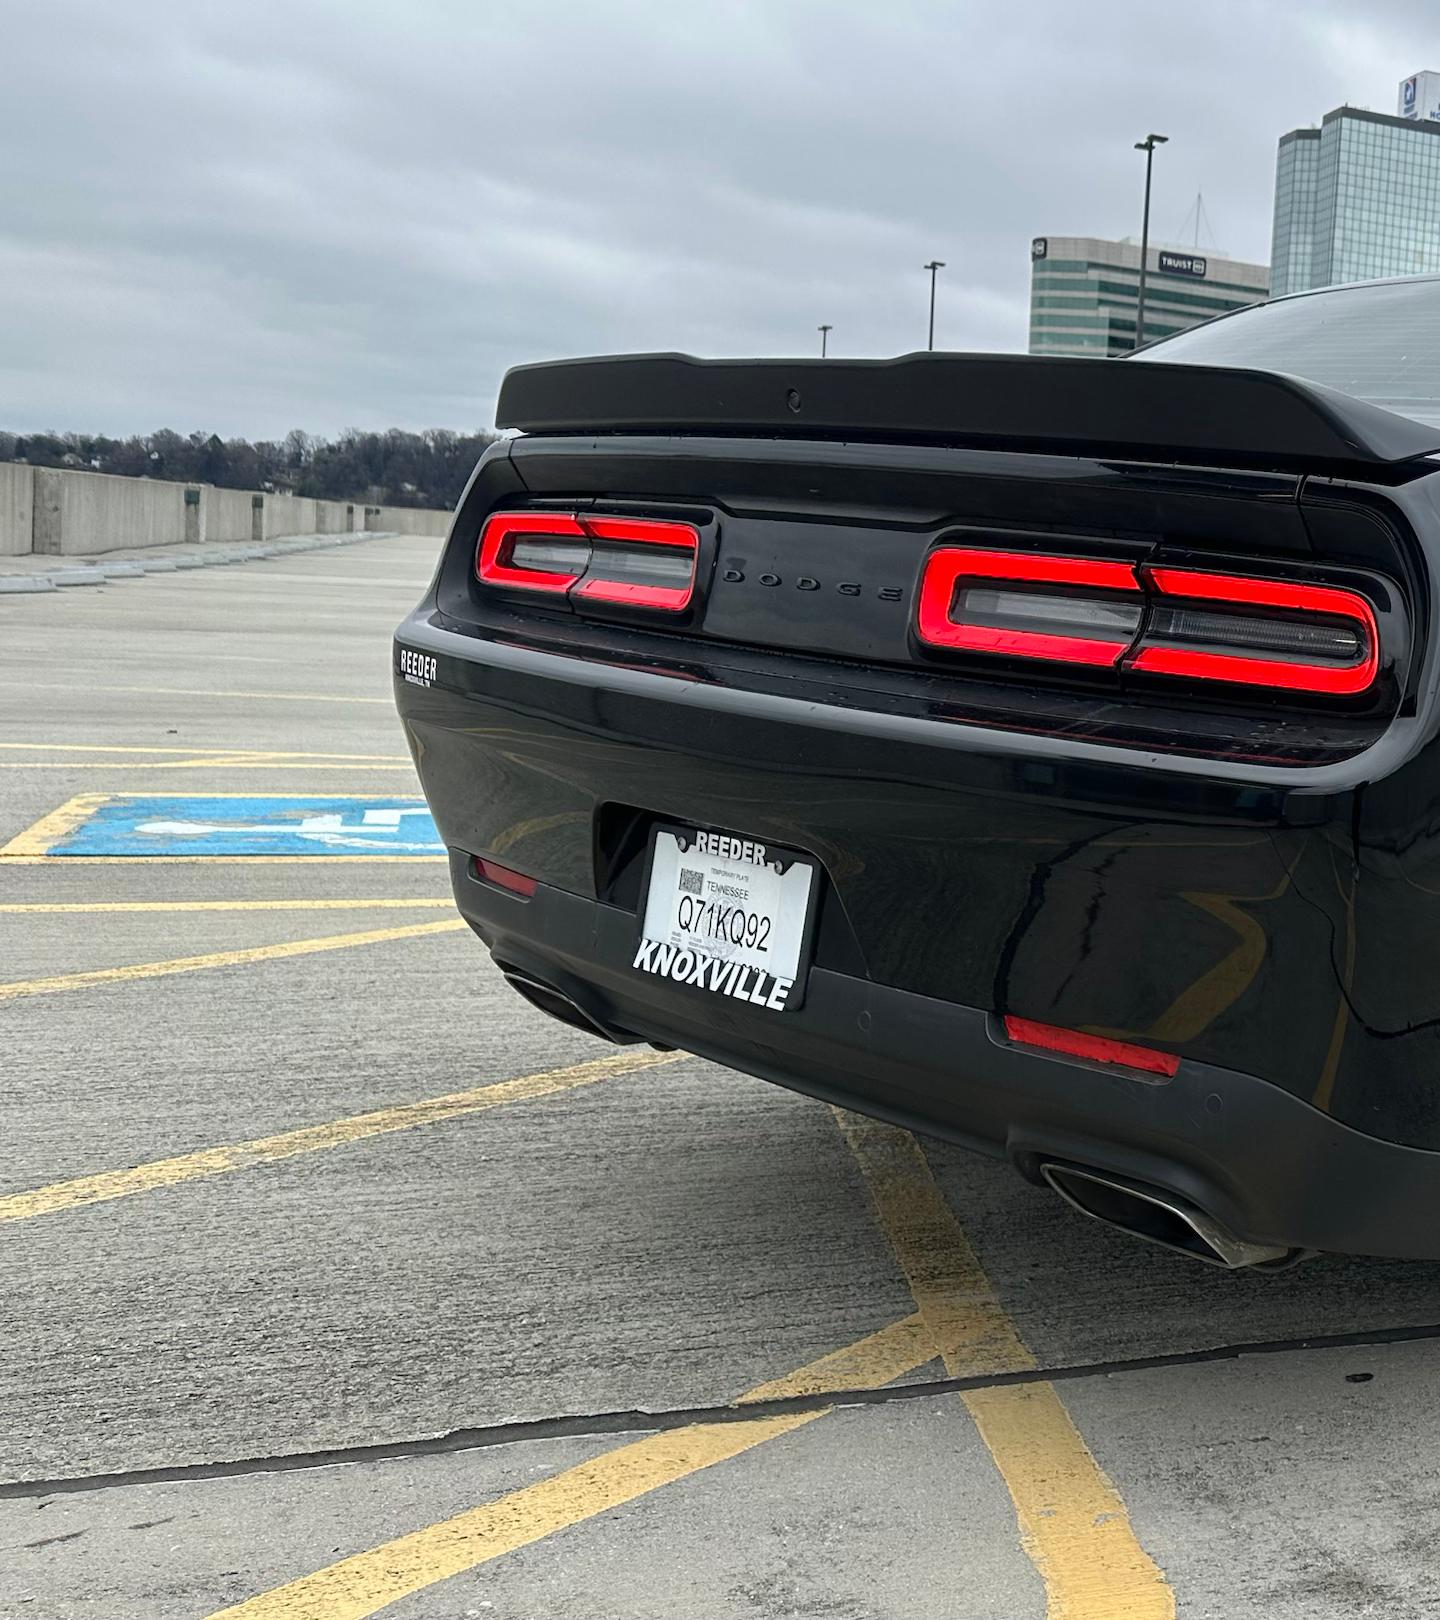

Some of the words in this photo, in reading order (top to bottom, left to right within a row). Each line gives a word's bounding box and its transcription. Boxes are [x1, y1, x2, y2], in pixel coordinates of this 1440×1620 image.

[1162, 256, 1192, 269] TRUIST
[723, 569, 903, 602] DODGE
[400, 649, 437, 681] REEDER
[695, 831, 766, 867] REEDER
[706, 880, 749, 900] TENNESSEE
[678, 895, 771, 952] Q71KQ92
[632, 938, 794, 1012] KNOXVILLE
